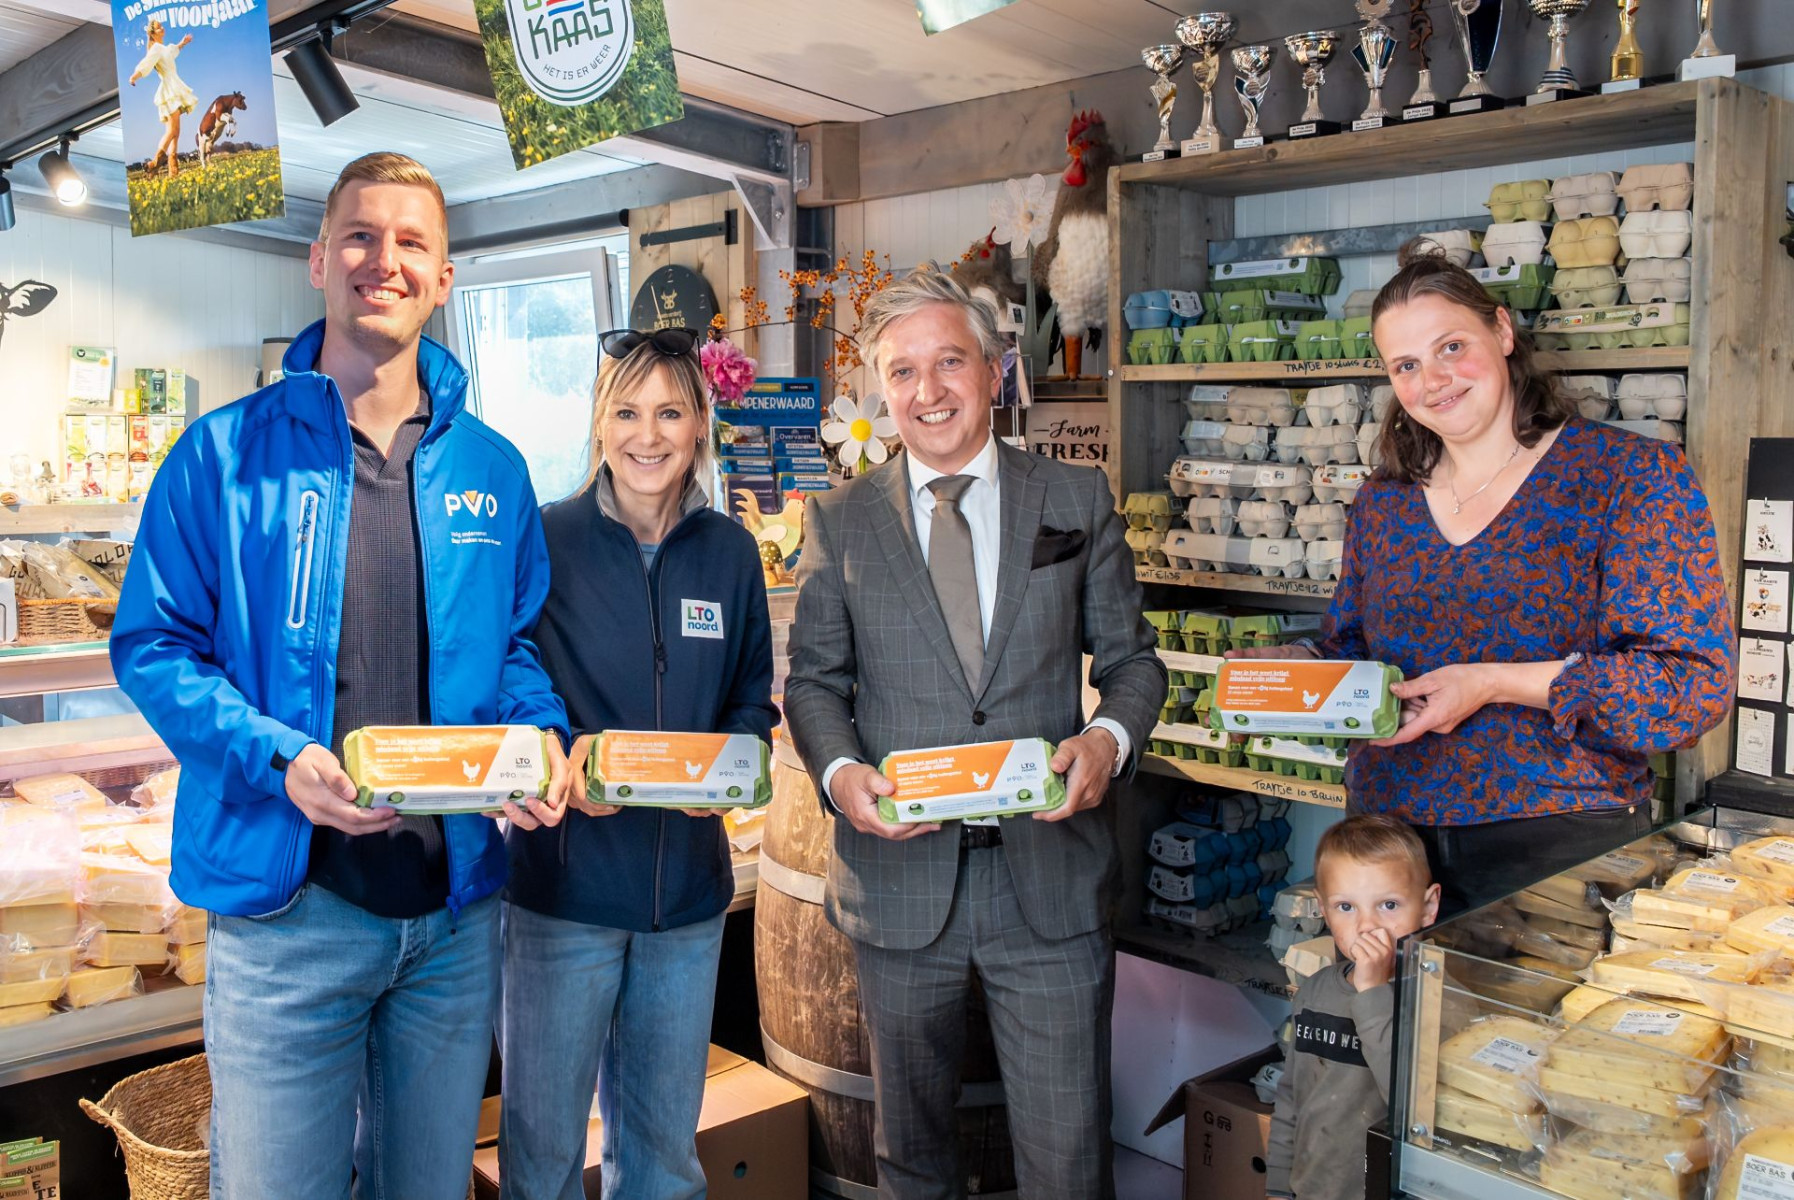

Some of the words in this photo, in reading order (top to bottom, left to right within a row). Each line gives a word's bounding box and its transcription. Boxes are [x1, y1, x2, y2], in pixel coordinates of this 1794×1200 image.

[168, 0, 258, 29] voorjaar
[528, 0, 614, 60] KAAS
[543, 64, 560, 79] HET
[562, 72, 574, 80] IS
[577, 65, 589, 78] ER
[591, 44, 611, 70] WEER
[740, 396, 815, 410] MPENERWAARD
[1049, 419, 1100, 439] Farm
[444, 491, 498, 518] PVO
[687, 606, 715, 622] LTO
[687, 621, 719, 632] noord
[1020, 762, 1036, 770] LTO
[1341, 1033, 1359, 1050] WE
